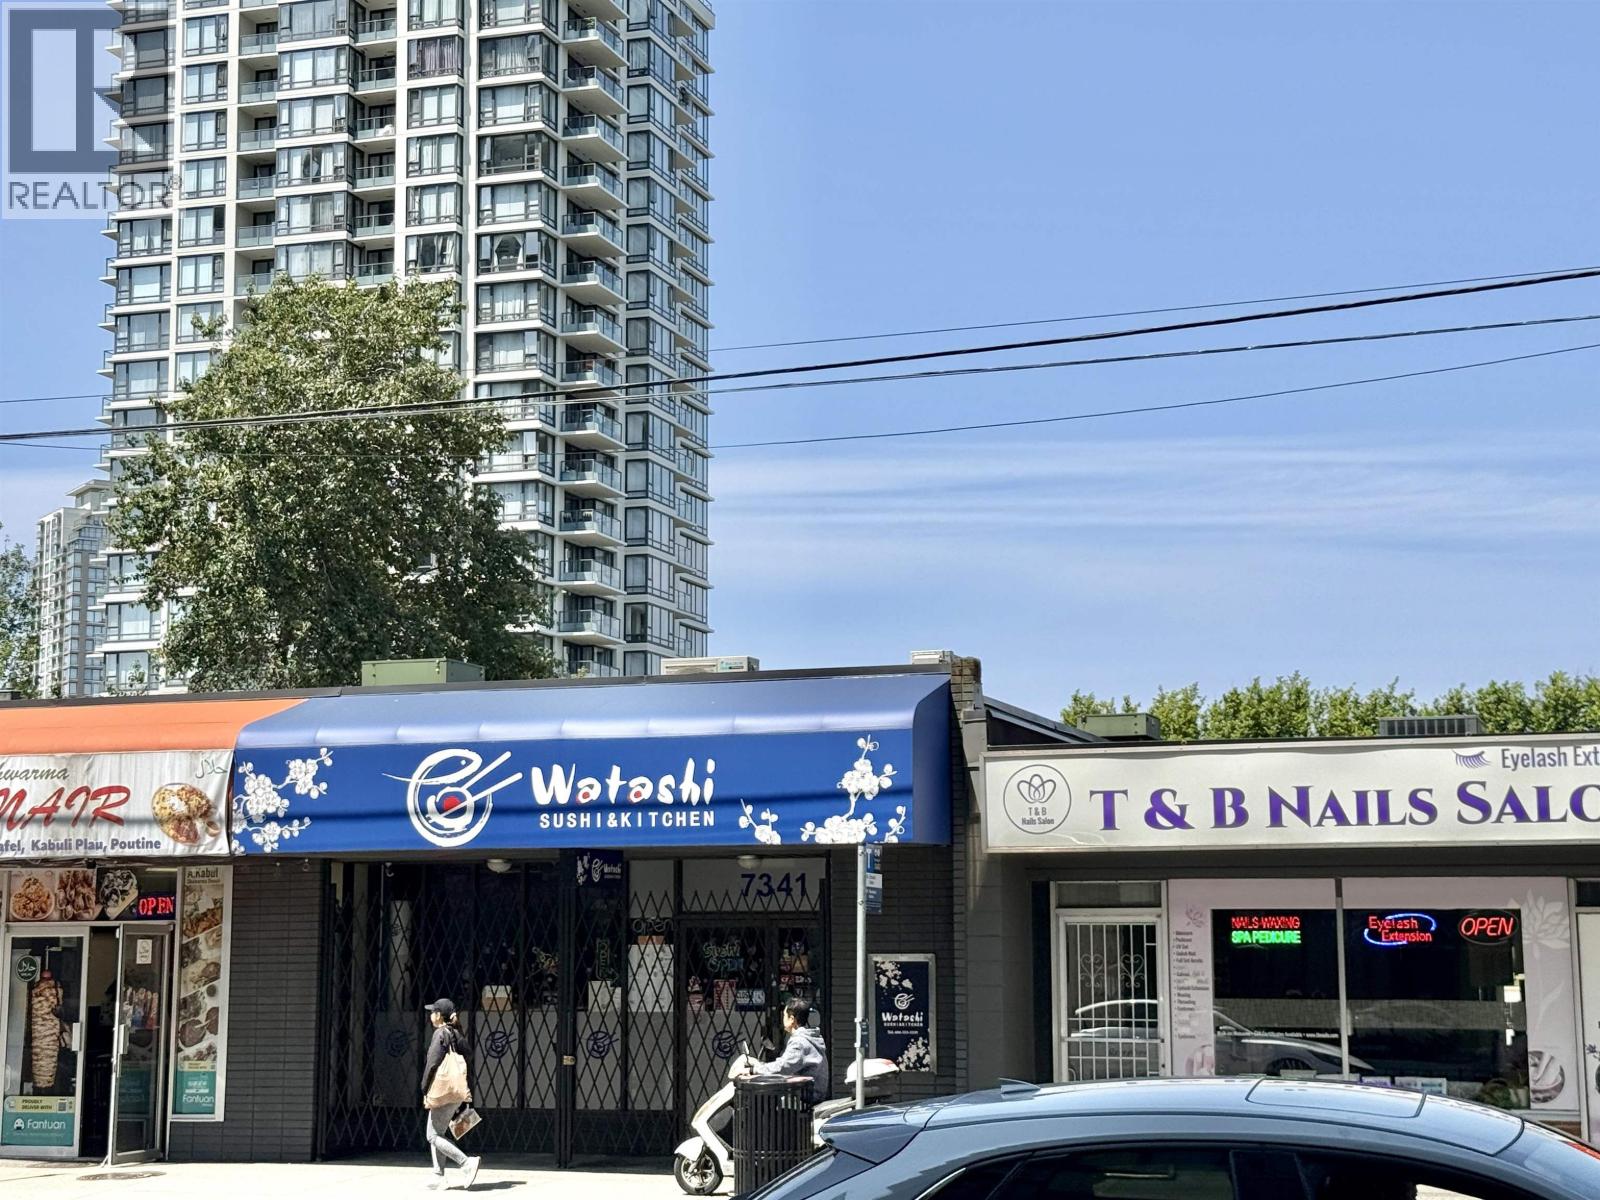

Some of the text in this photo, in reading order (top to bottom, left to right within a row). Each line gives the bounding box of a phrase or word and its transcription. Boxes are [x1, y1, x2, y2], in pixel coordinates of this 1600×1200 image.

[1501, 746, 1600, 771] Eyelash Ext
[531, 757, 716, 806] Watashi
[1028, 807, 1047, 816] T & B
[1089, 789, 1128, 831] T
[1144, 788, 1196, 831] &
[1210, 787, 1249, 829] B
[1265, 785, 1438, 829] NAILS
[540, 811, 715, 829] SUSHI&KITCHEN
[1021, 816, 1055, 826] Nails Salon
[31, 839, 73, 852] Kabuli
[75, 838, 108, 851] Plau,
[110, 837, 162, 850] Poutine
[741, 872, 808, 898] 7341
[138, 896, 175, 916] OPEN
[1369, 916, 1418, 932] Eyelash
[1461, 917, 1514, 936] OPEN
[1381, 930, 1433, 943] Extension
[881, 1011, 923, 1022] Watashi
[183, 1094, 214, 1103] Fantuan
[27, 1118, 66, 1129] Fantuan
